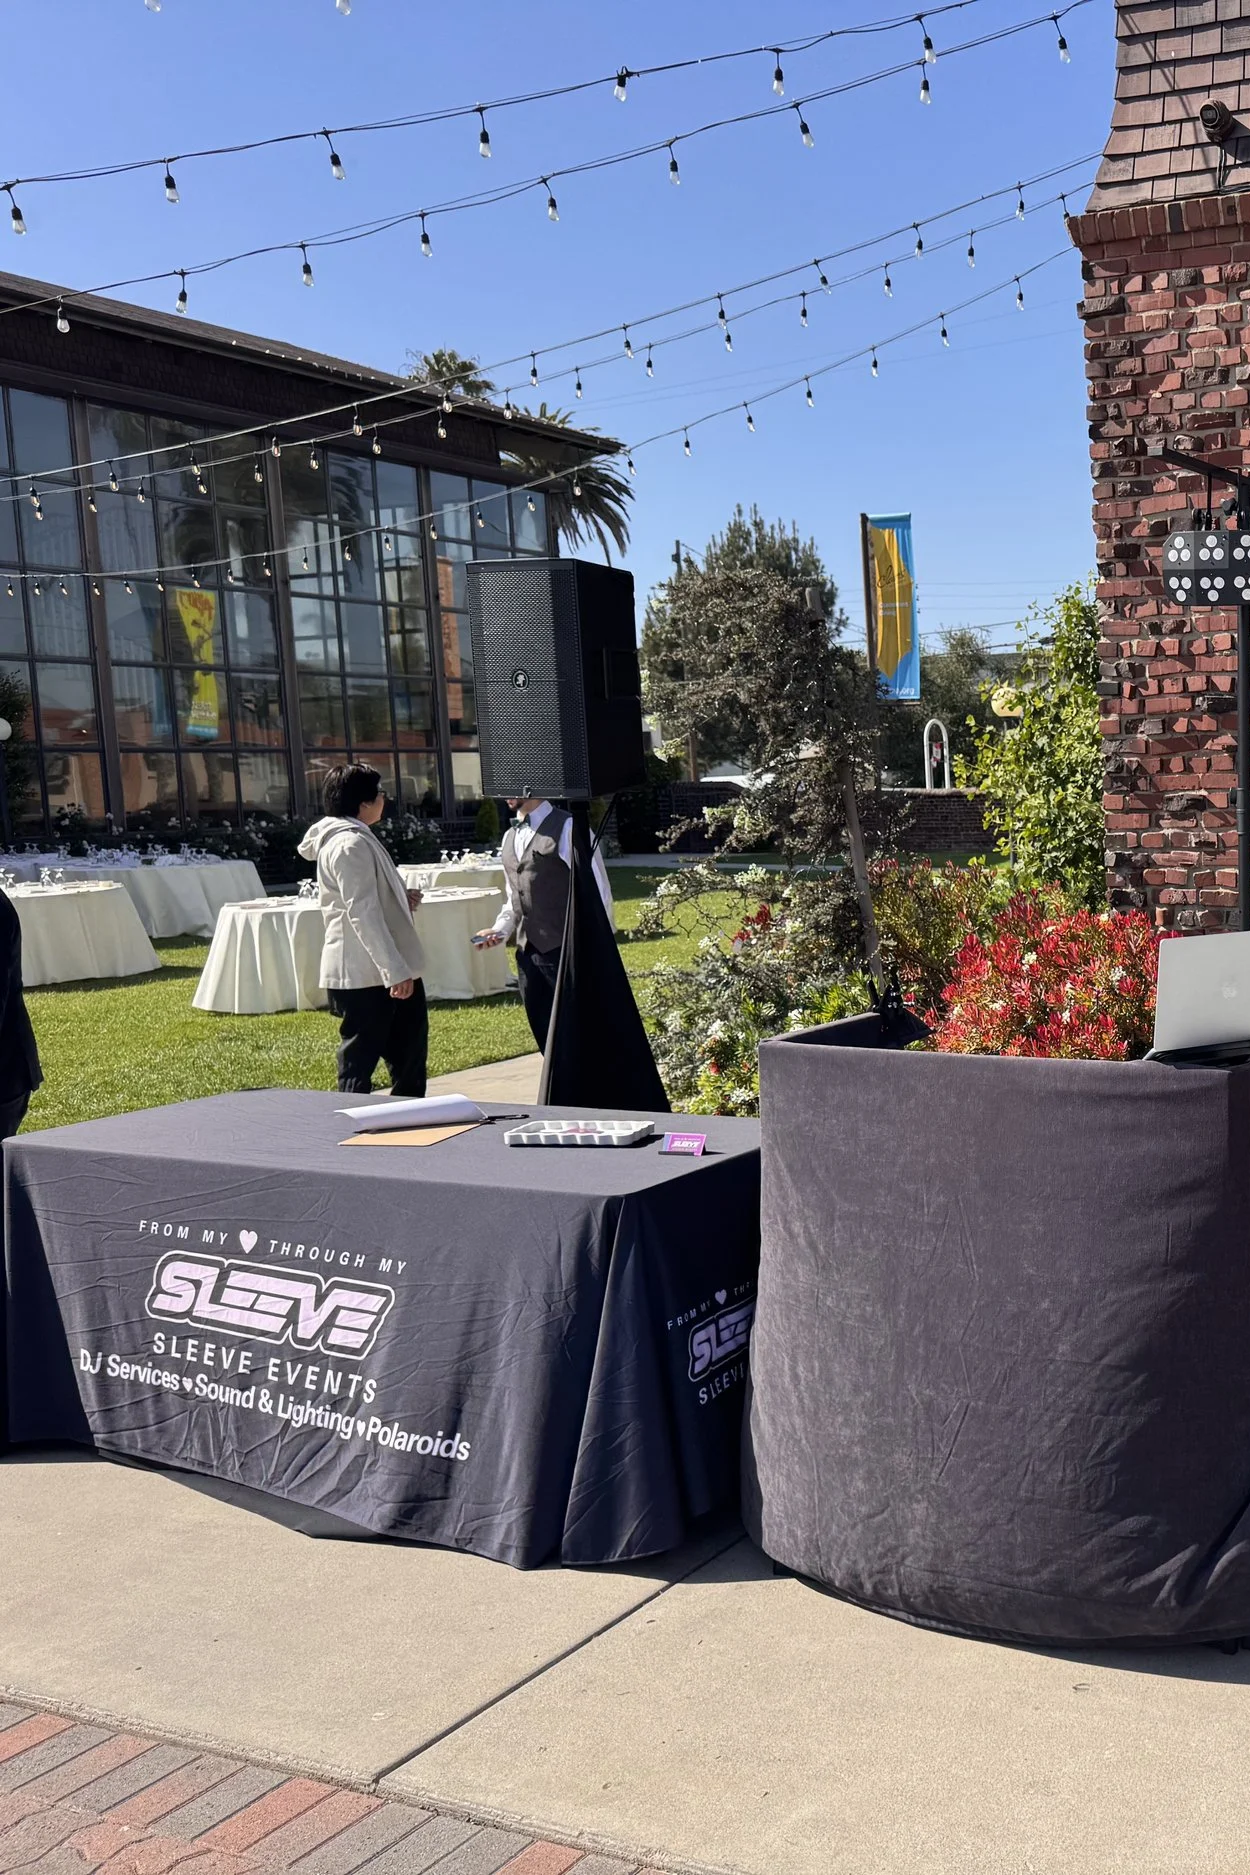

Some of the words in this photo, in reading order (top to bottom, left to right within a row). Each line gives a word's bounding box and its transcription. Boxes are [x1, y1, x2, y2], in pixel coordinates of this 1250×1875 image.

[139, 1220, 190, 1239] FROM
[202, 1230, 228, 1245] MY
[269, 1240, 366, 1268] THROUGH
[379, 1258, 407, 1275] MY
[149, 1256, 391, 1354] SLEEVE
[667, 1308, 697, 1331] FROM
[152, 1332, 253, 1374] SLEEVE
[267, 1357, 378, 1404] EVENTS
[80, 1348, 103, 1374] DJ
[107, 1354, 180, 1391] Services
[195, 1373, 256, 1409] Sound
[258, 1388, 274, 1415] &
[277, 1393, 355, 1440] Lighting
[366, 1416, 471, 1461] Polaroids
